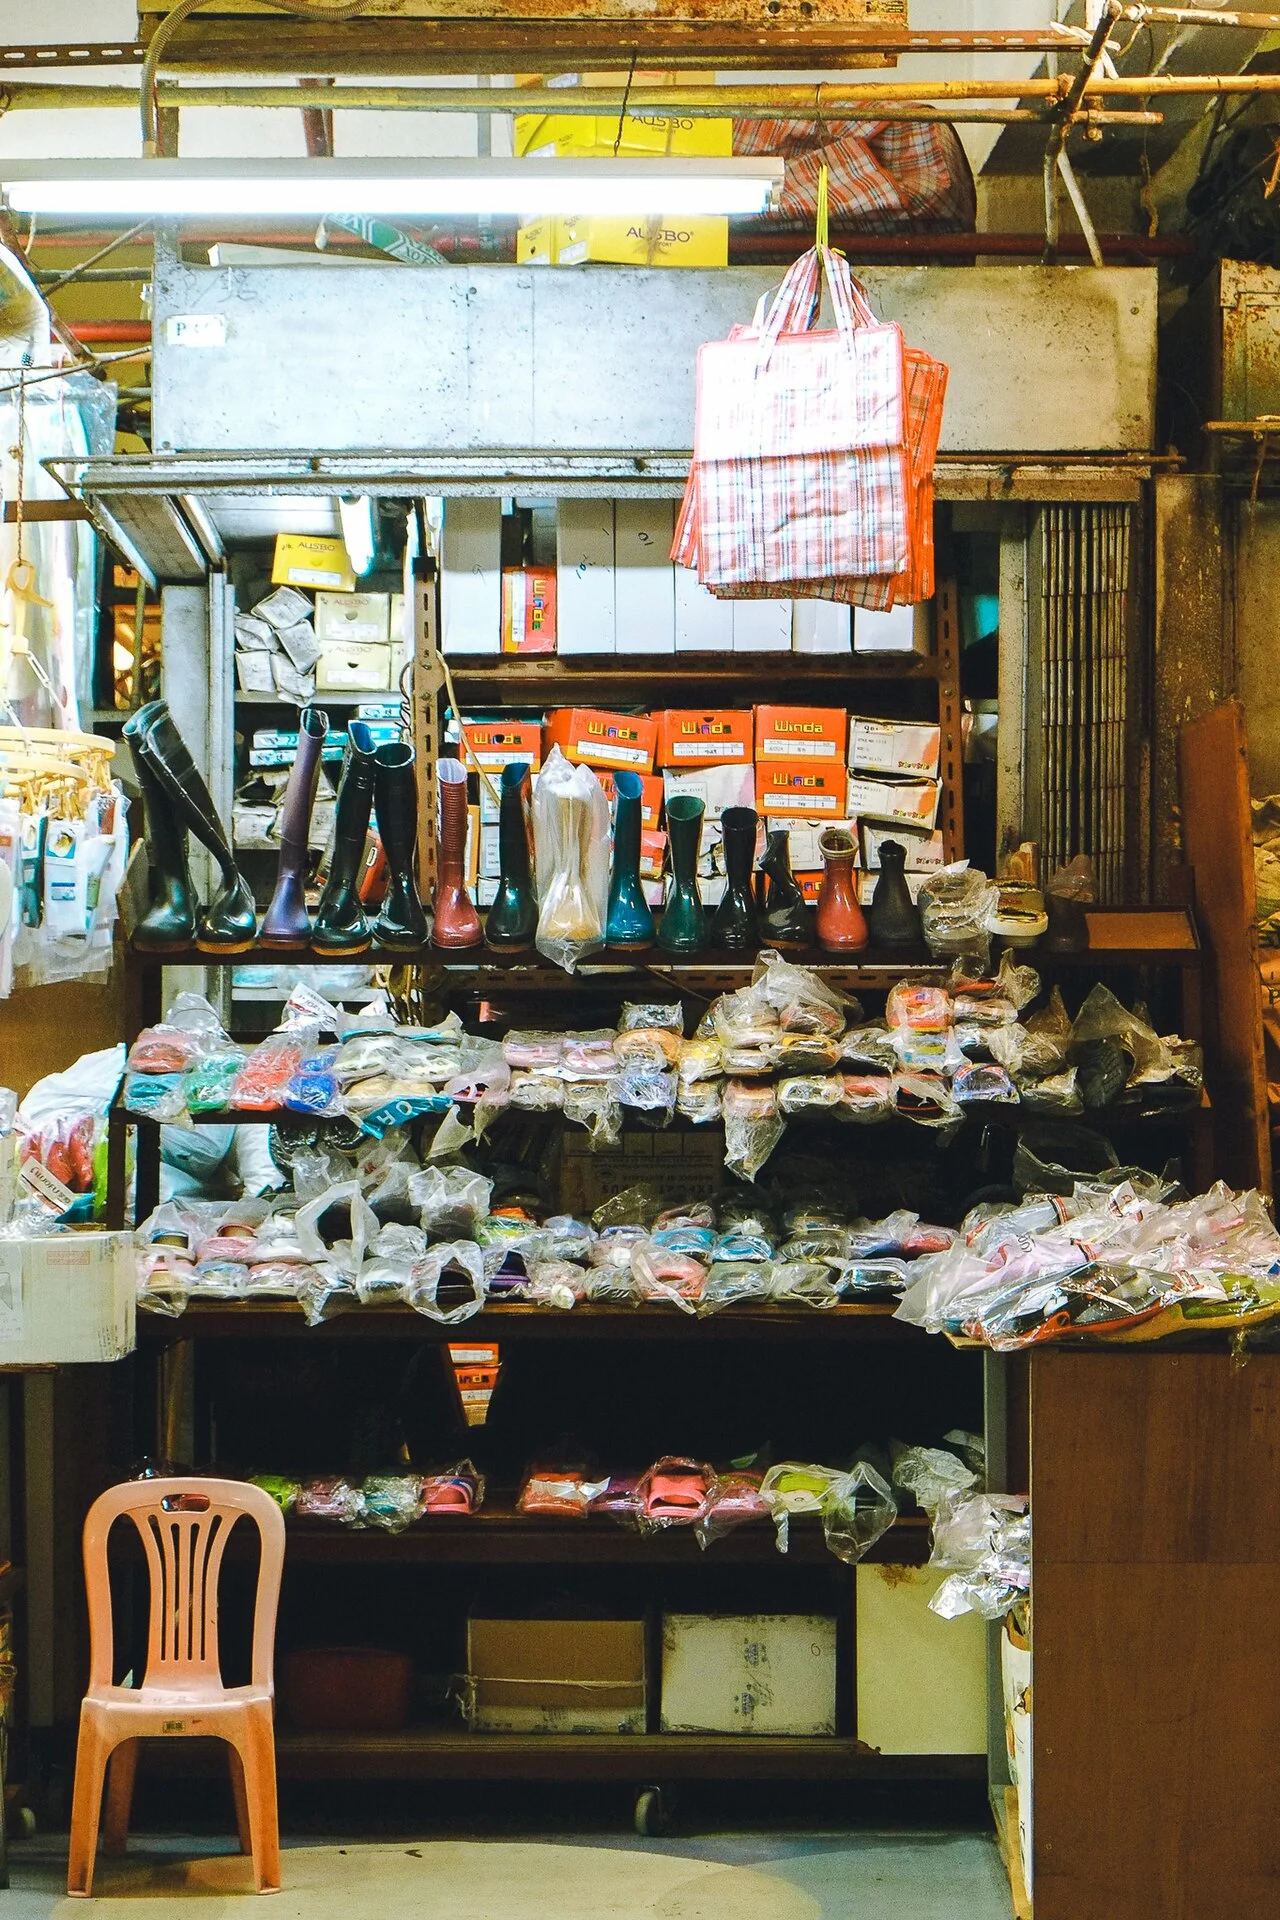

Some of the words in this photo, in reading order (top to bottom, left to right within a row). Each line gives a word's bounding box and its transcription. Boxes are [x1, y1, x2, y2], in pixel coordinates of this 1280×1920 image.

[588, 720, 639, 741] Winda
[681, 721, 732, 735] Winda
[774, 719, 825, 734] Winda
[773, 772, 825, 787] Winda
[458, 1373, 490, 1384] inda
